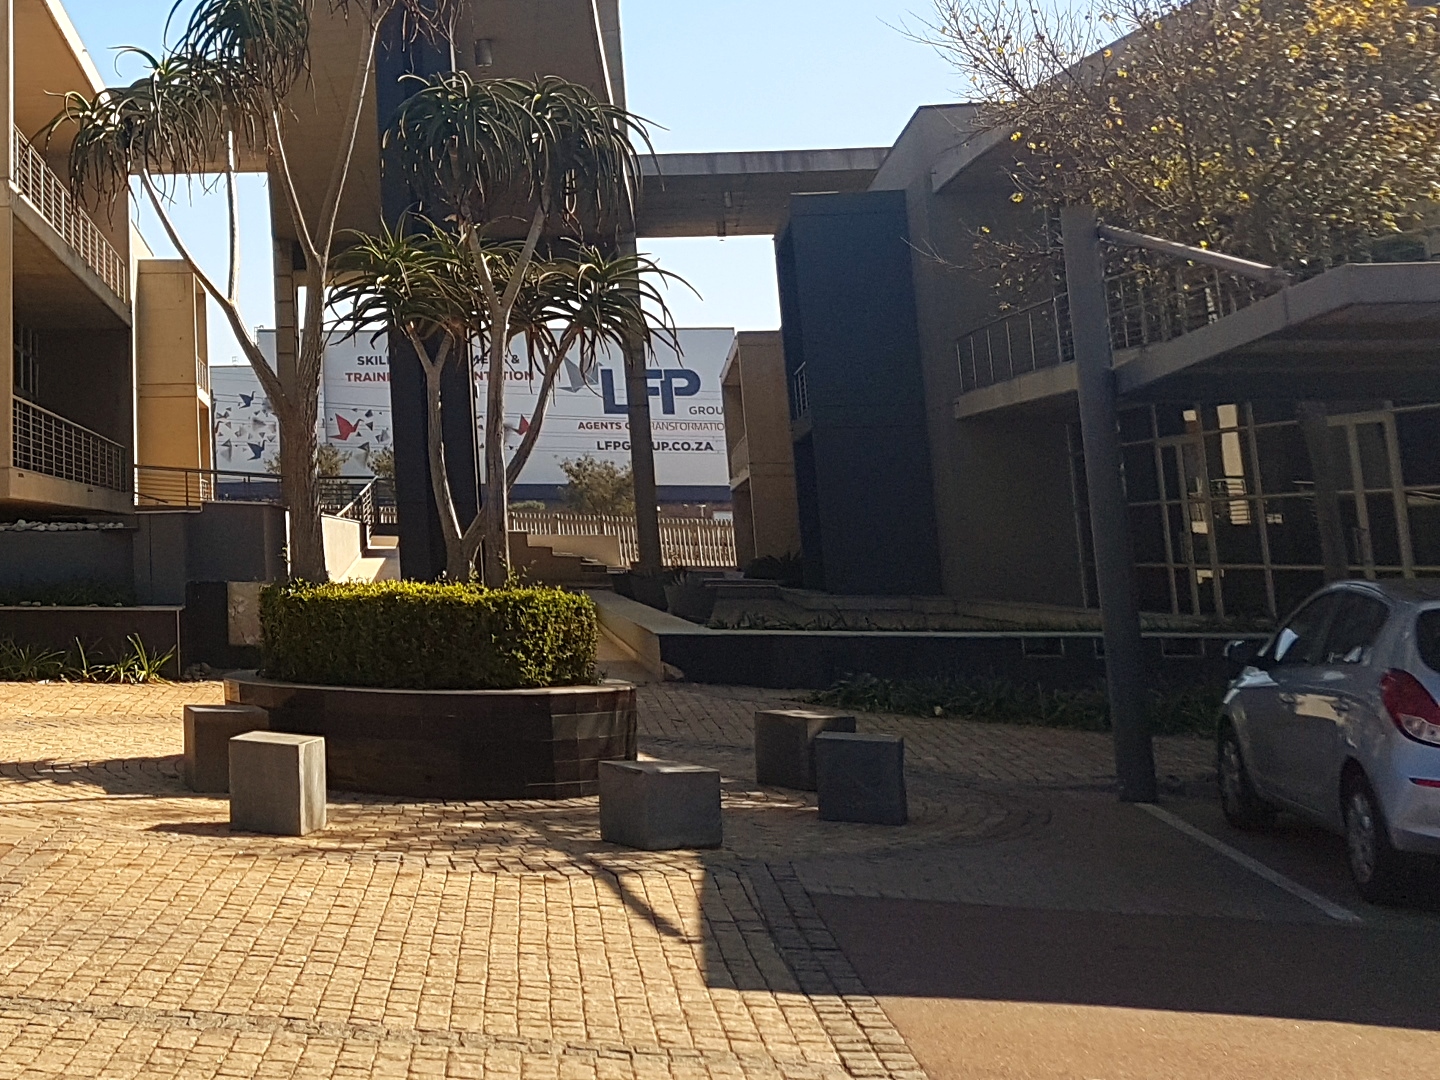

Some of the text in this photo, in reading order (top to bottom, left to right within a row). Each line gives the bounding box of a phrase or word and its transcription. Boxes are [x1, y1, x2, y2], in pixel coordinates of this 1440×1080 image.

[345, 372, 391, 382] TRAINI
[688, 405, 724, 415] GROU
[578, 421, 622, 430] AGENTS
[651, 422, 725, 431] ANSFORMATIO
[597, 440, 714, 451] LFPGUP.CO.ZA
